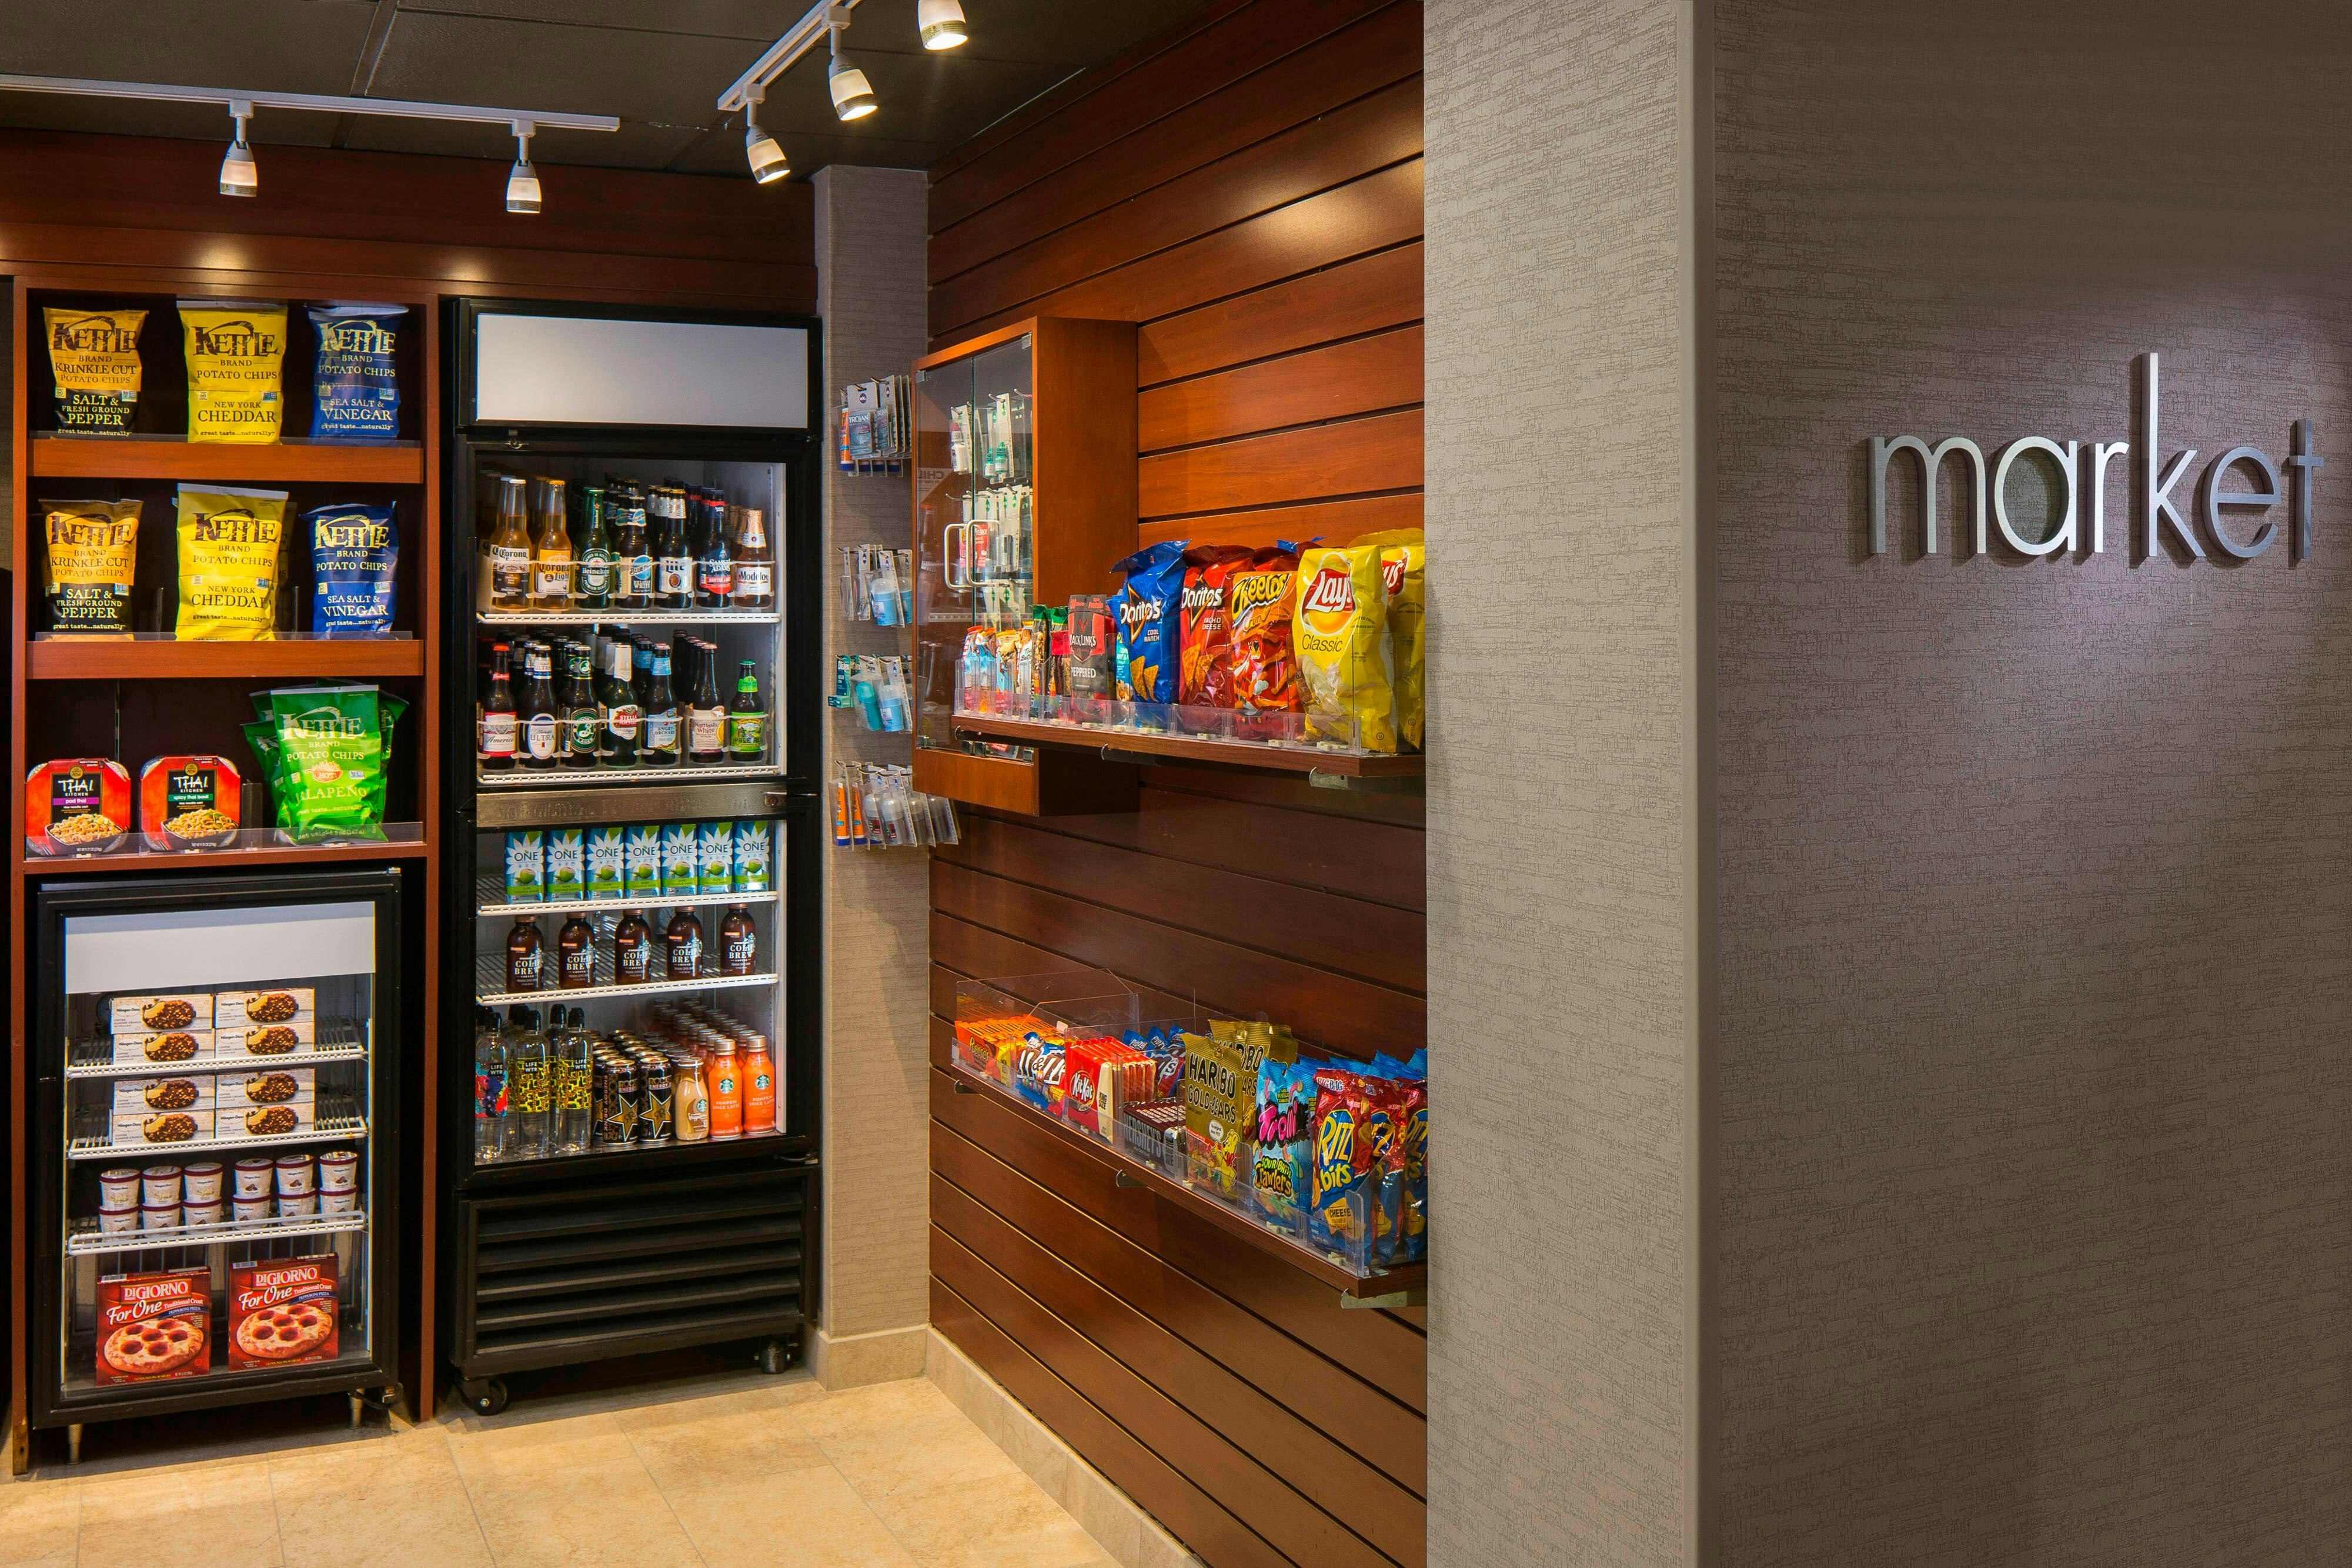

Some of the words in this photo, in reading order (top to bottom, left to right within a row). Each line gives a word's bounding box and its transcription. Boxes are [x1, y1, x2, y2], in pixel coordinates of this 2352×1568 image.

[49, 316, 137, 353] KETTLE
[191, 320, 278, 357] KETTLE
[318, 320, 396, 355] KETTLE
[342, 355, 373, 363] BRAND
[55, 363, 109, 374] KRINKLE
[111, 365, 137, 375] CUT
[197, 370, 240, 379] POTATO
[244, 371, 277, 379] CHIPS
[318, 365, 361, 374] POTATO
[364, 367, 396, 377] CHIPS
[61, 375, 99, 383] POTATO
[72, 394, 108, 405] SALT
[351, 399, 375, 407] SALT
[67, 413, 123, 426] PEPPER
[198, 410, 276, 423] CHEDDAR
[323, 409, 393, 420] VINEGAR
[848, 415, 869, 423] TROJAN
[1867, 352, 2324, 559] market
[48, 514, 135, 547] KETTLE
[191, 509, 278, 543] KETTLE
[314, 514, 390, 550] KETTLE
[499, 550, 527, 558] Corona
[51, 557, 103, 567] KRINKLE
[106, 558, 129, 568] CUT
[193, 555, 238, 564] POTATO
[241, 557, 273, 567] CHIPS
[316, 561, 356, 571] POTATO
[360, 561, 387, 570] CHIPS
[66, 589, 101, 599] SALT
[103, 591, 112, 599] &
[1181, 587, 1223, 609] Doritos
[61, 607, 118, 618] PEPPER
[323, 605, 389, 617] VINEGAR
[1120, 600, 1161, 624] Doritos
[1302, 634, 1343, 651] Classic
[1071, 667, 1097, 678] PEPPERED
[279, 706, 366, 741] KETTLE
[286, 751, 329, 762] POTATO
[332, 751, 365, 760] CHIPS
[58, 779, 93, 793] THAI
[173, 776, 208, 790] THAI
[296, 784, 367, 806] JALAPEÑO
[1189, 1052, 1236, 1100] HARIBO
[1329, 1079, 1344, 1092] BAG
[1098, 1101, 1107, 1110] SIZE
[1187, 1084, 1237, 1124] GOLD-BEARS
[1259, 1099, 1297, 1142] Trolli
[1318, 1116, 1355, 1166] RITZ
[1262, 1156, 1277, 1169] SOUR
[1255, 1163, 1292, 1197] Crawlers
[1321, 1162, 1352, 1193] bits
[1330, 1207, 1351, 1218] CHEESE
[294, 1285, 319, 1294] Traditional
[163, 1300, 190, 1309] Traditional
[239, 1291, 263, 1310] For
[264, 1286, 292, 1303] One
[106, 1305, 132, 1325] For
[133, 1300, 162, 1318] One
